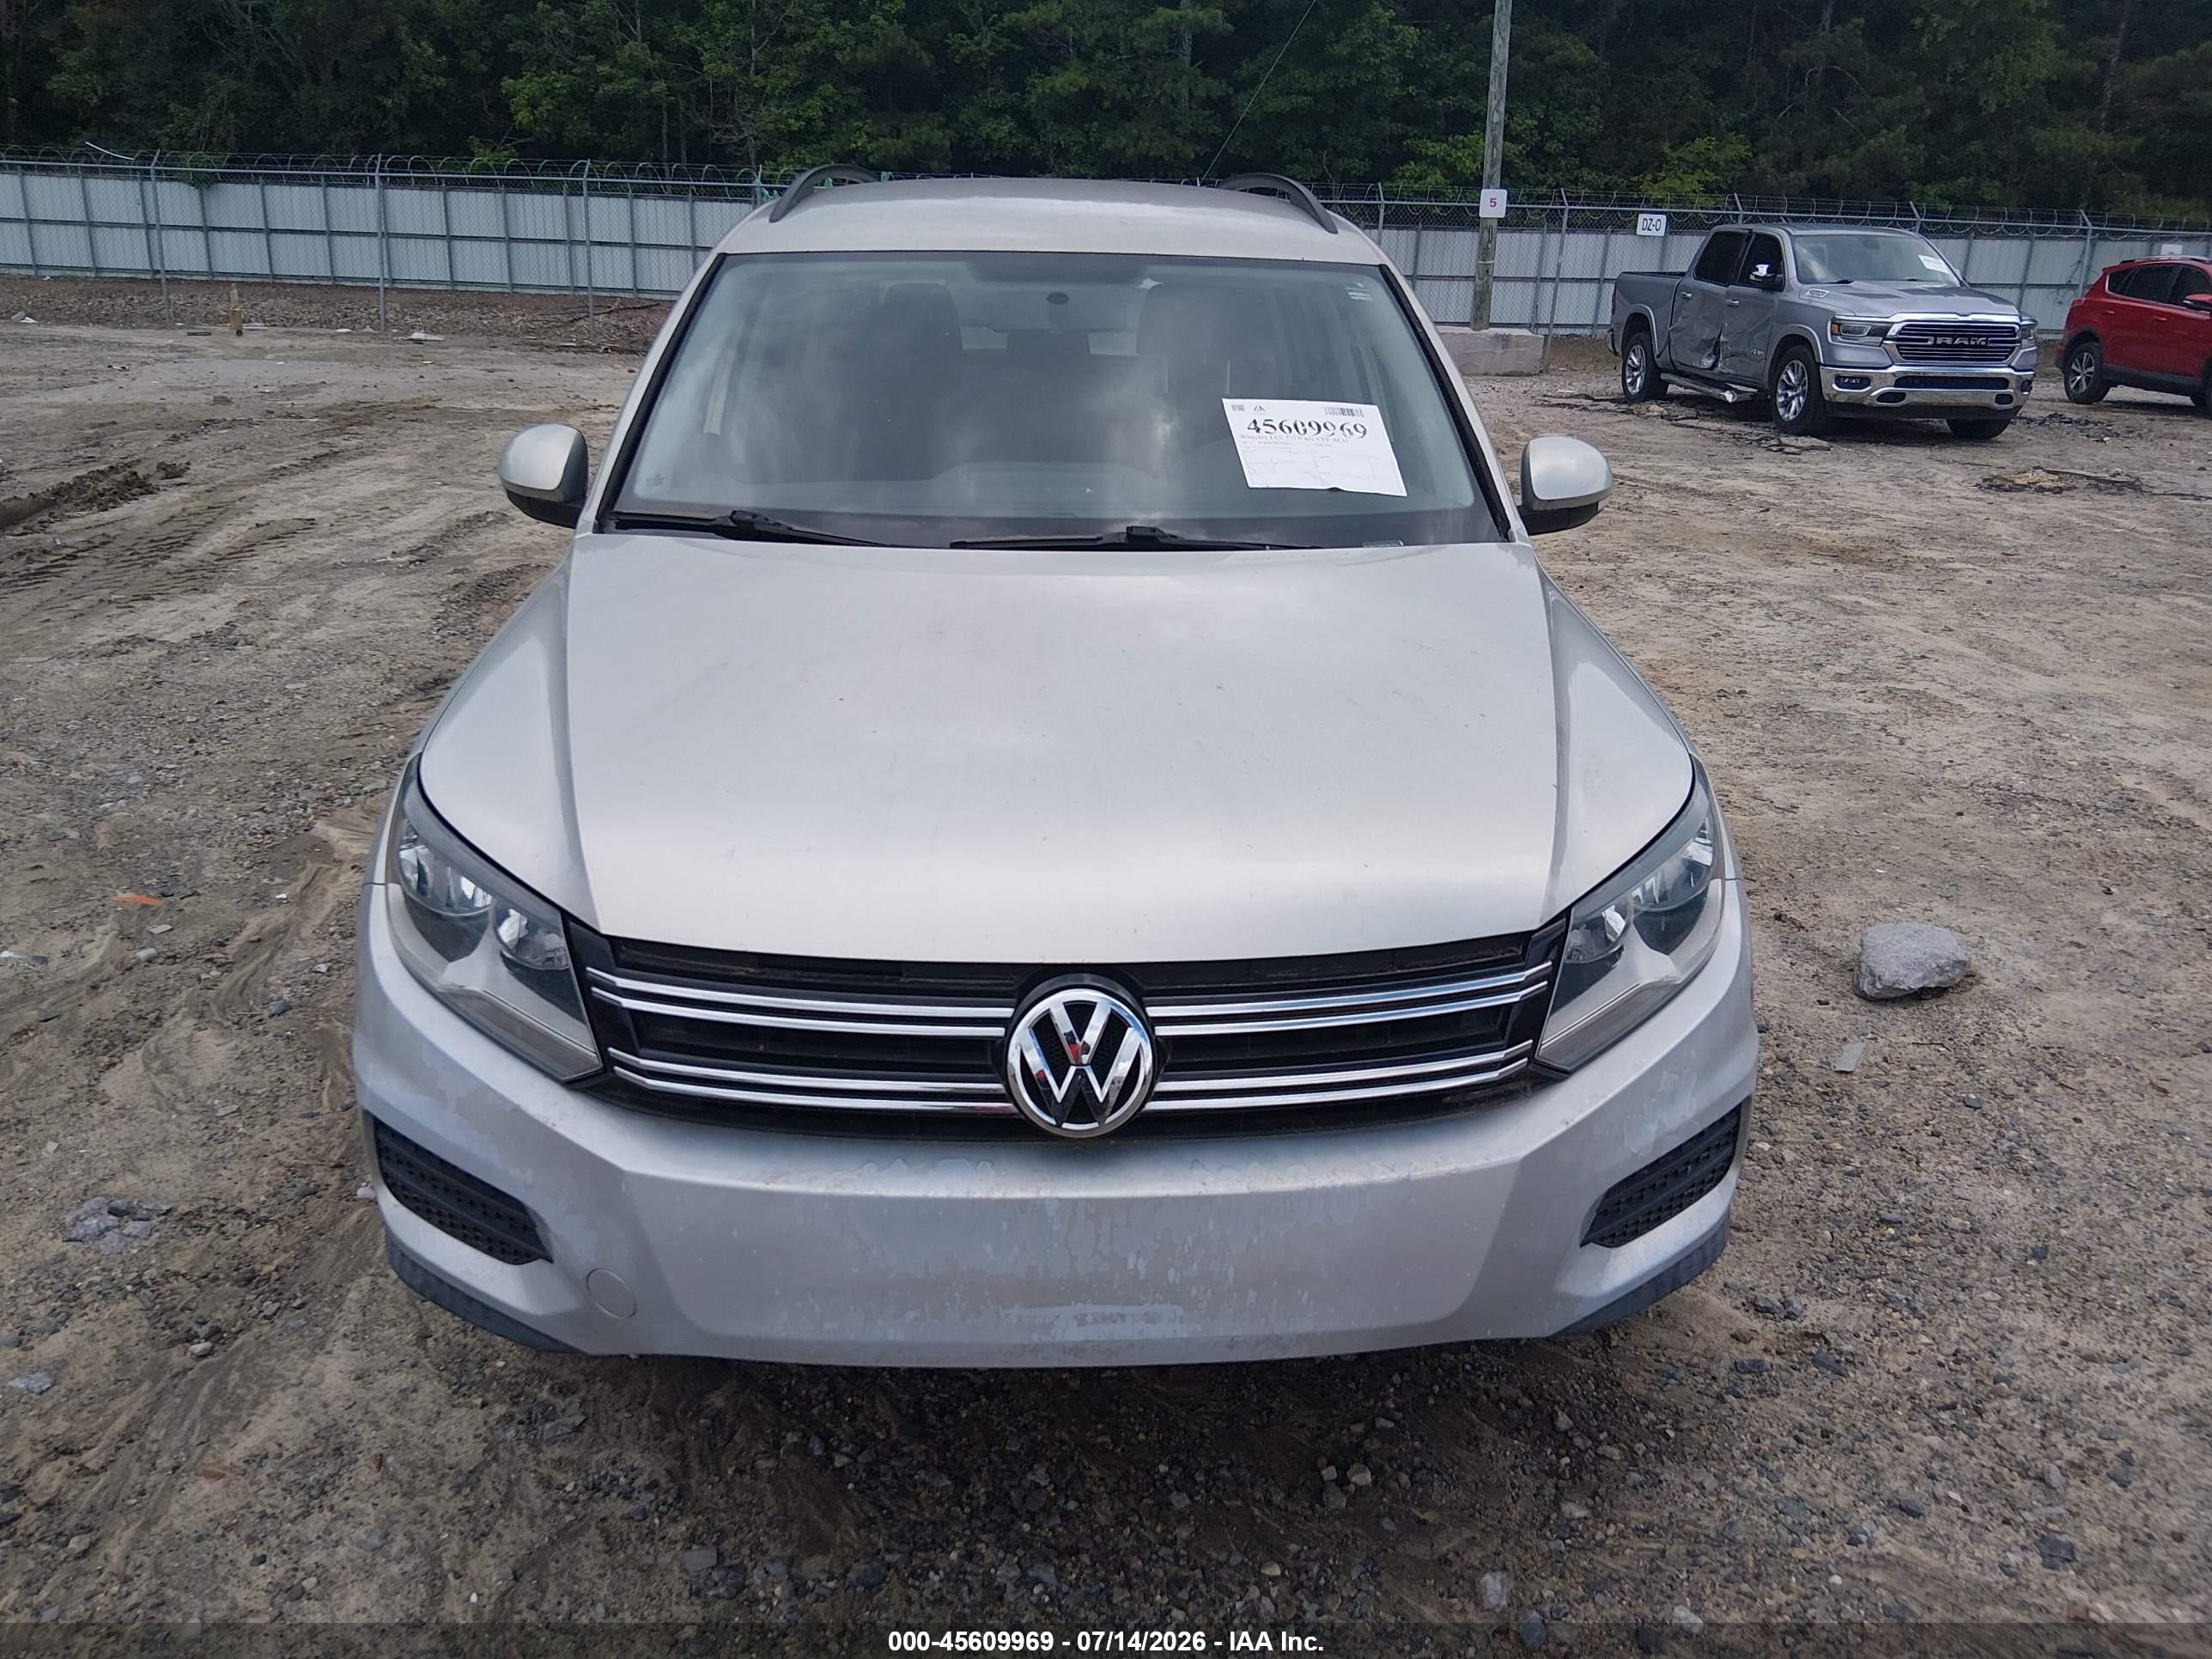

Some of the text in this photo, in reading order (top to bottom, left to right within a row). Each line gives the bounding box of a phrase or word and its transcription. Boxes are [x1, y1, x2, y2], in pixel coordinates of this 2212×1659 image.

[1489, 198, 1498, 208] 5
[1936, 337, 1987, 345] RAM
[1246, 417, 1368, 440] 45609969
